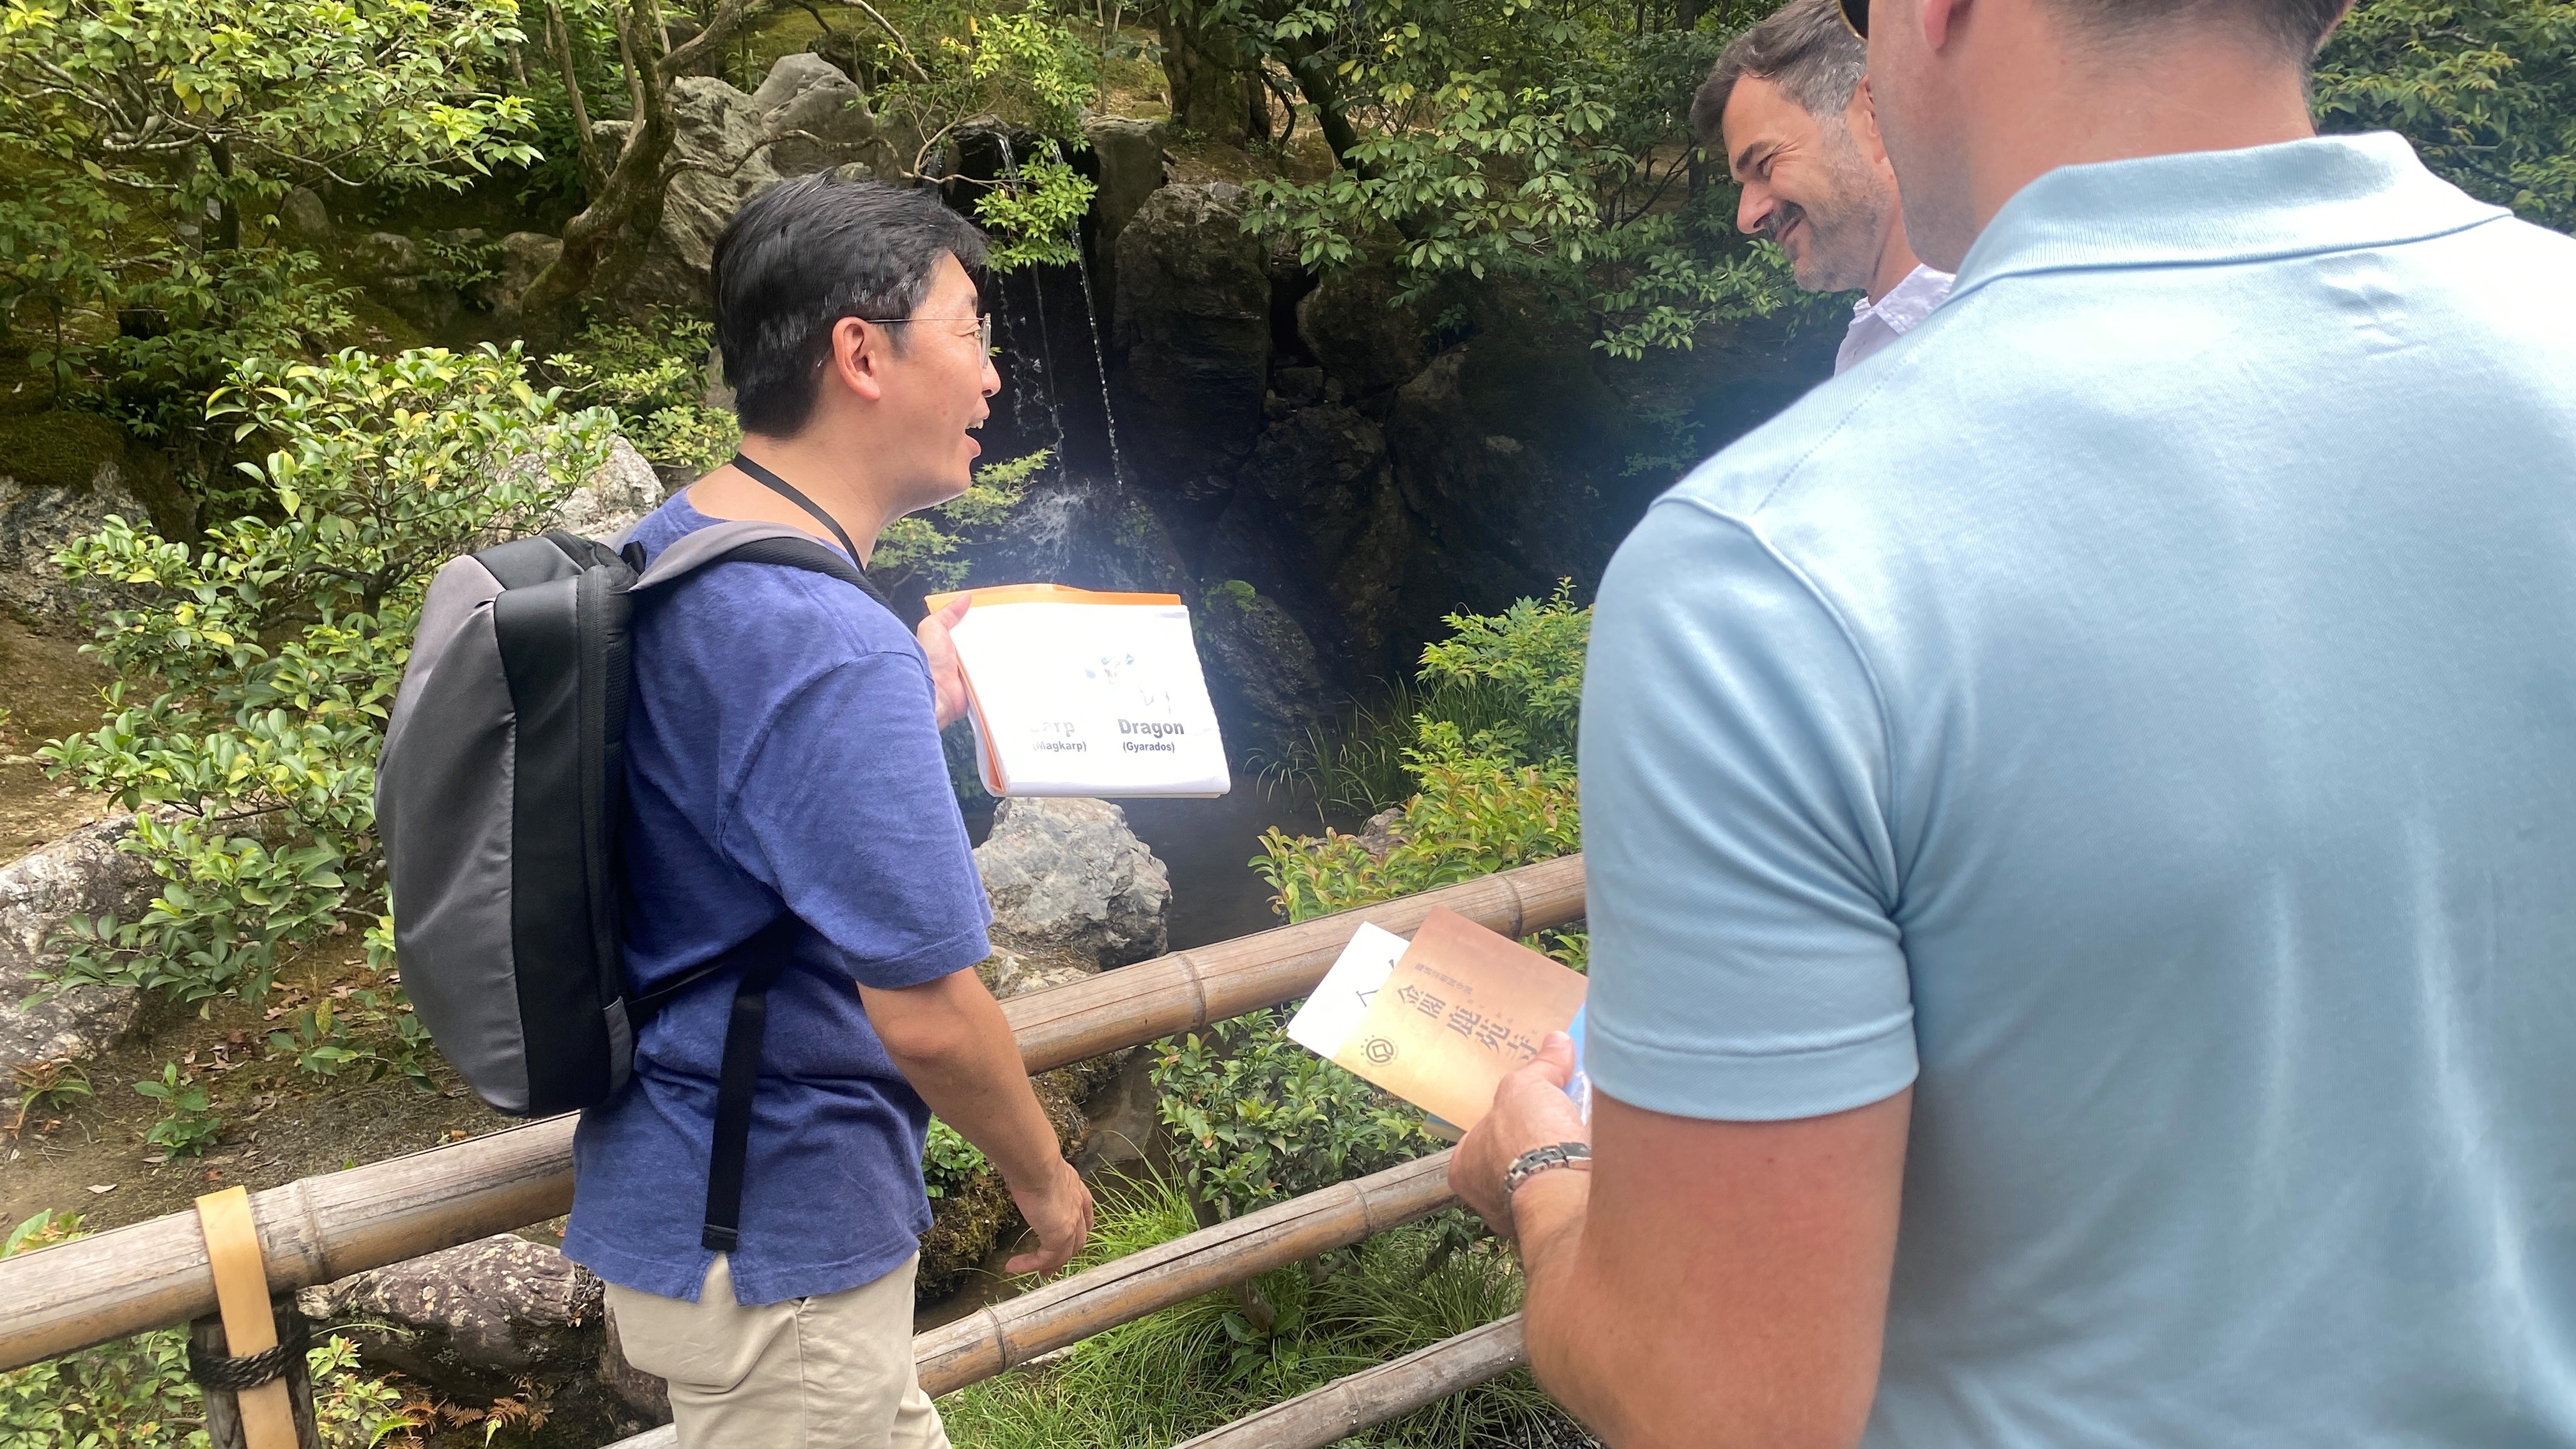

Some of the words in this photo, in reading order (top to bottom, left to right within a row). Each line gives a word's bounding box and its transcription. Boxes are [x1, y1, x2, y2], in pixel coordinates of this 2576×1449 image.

[1117, 718, 1184, 739] Dragon
[1032, 741, 1087, 753] (Magkarp)
[1123, 742, 1175, 753] (Gyarados)
[1397, 984, 1446, 1020] 金閣
[1446, 1005, 1538, 1061] 鹿苑寺
